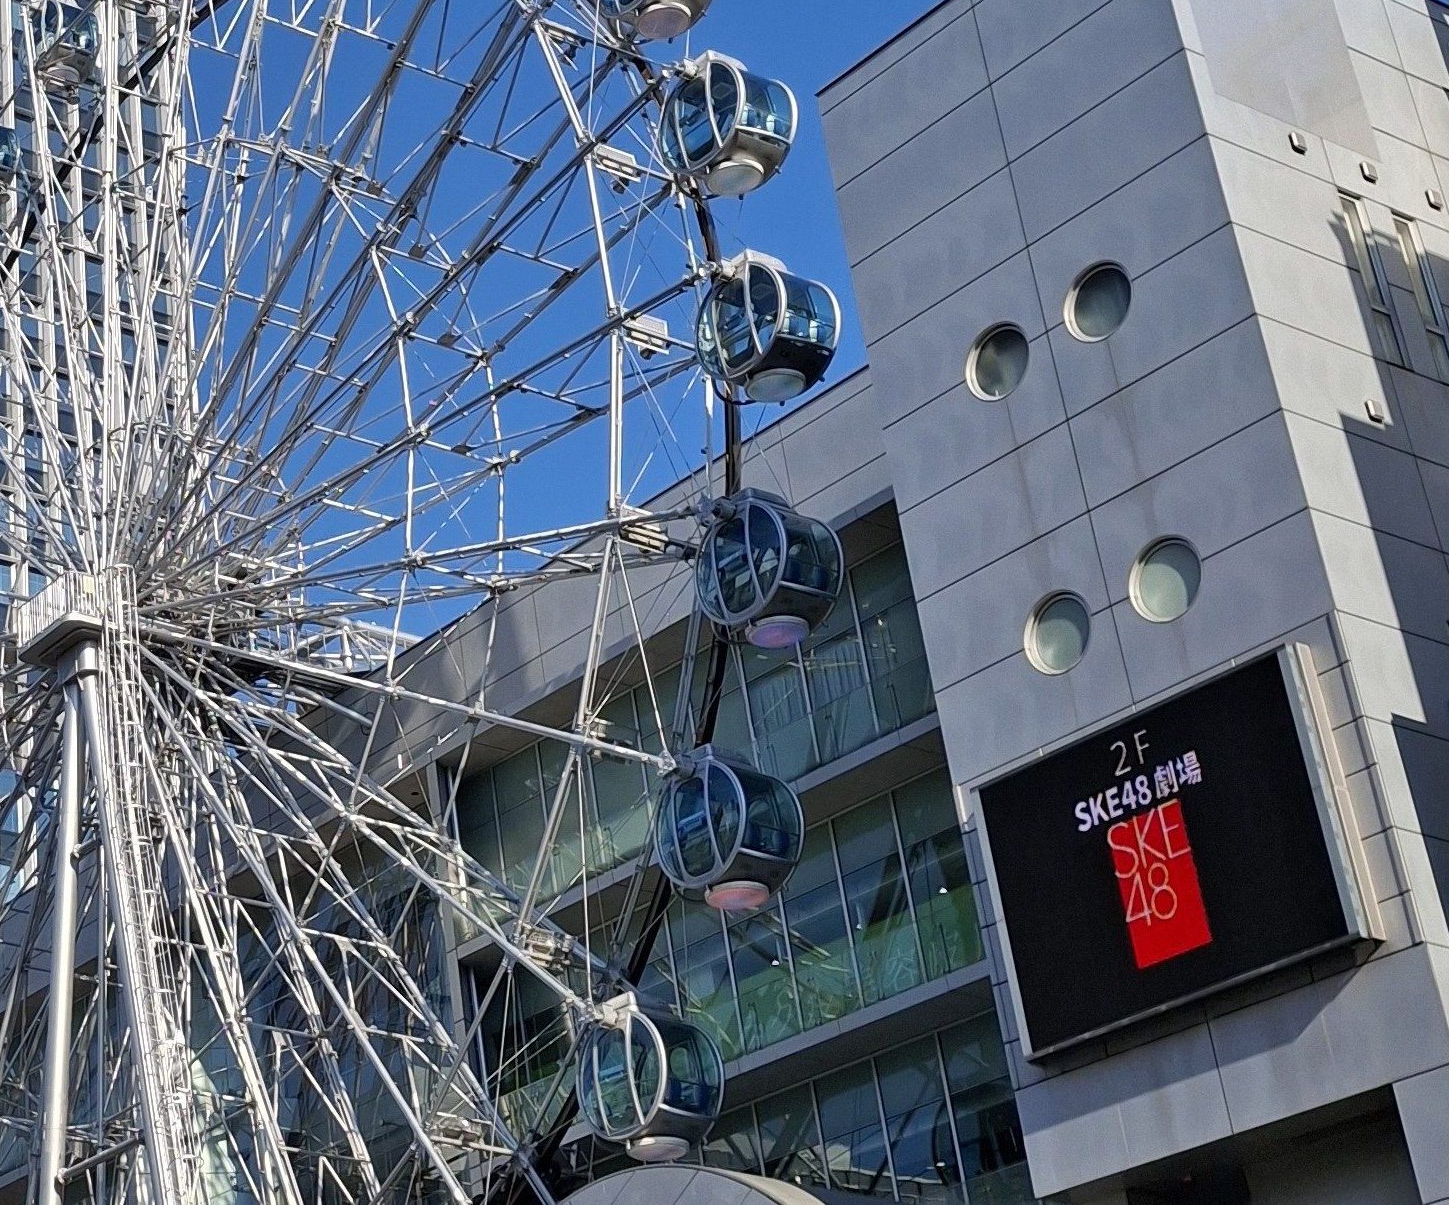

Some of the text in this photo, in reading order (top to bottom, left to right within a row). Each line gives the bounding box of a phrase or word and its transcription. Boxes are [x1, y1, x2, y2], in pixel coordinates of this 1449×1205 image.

[1110, 730, 1150, 776] 2F
[1075, 751, 1202, 832] SKE48劇場
[1107, 798, 1191, 878] SKE
[1125, 862, 1178, 926] 48
